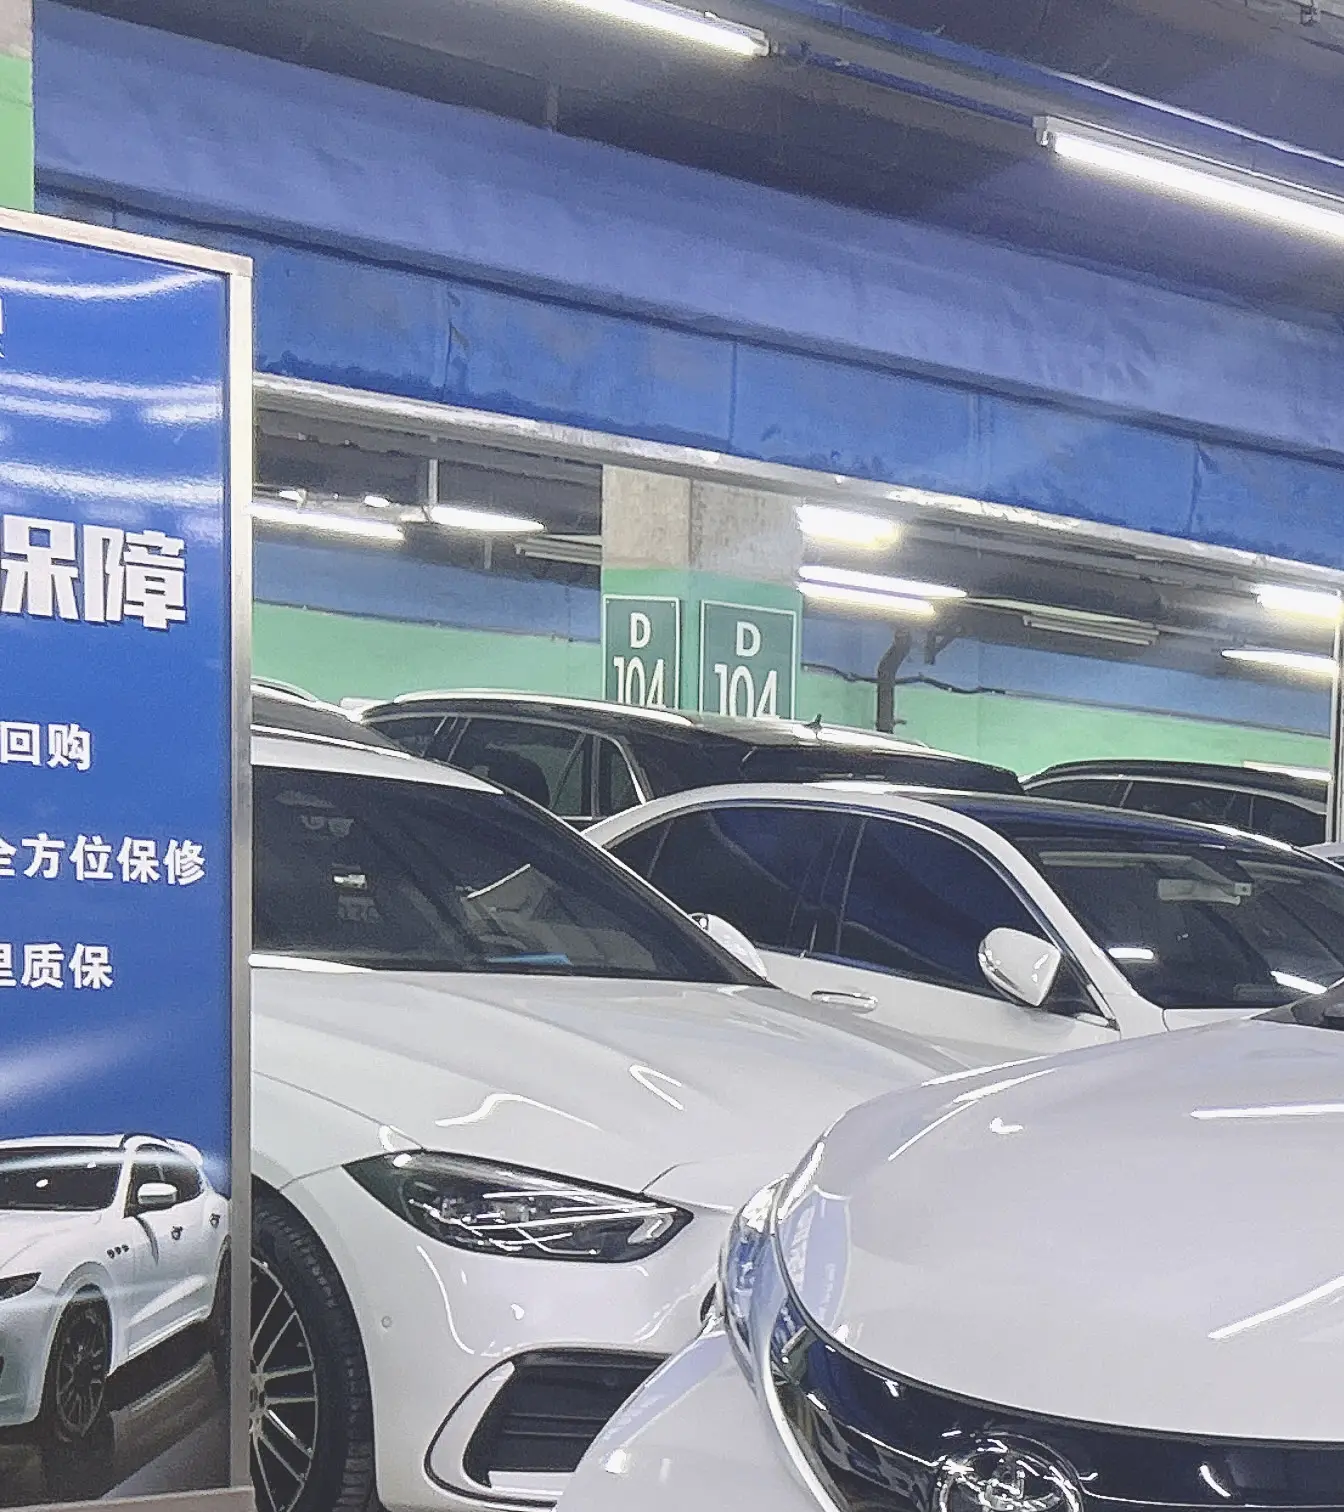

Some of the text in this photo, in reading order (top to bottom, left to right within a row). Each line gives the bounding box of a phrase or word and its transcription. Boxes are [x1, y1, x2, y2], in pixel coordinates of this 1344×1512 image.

[630, 612, 652, 649] D
[736, 621, 762, 657] D
[613, 656, 667, 710] 104
[714, 662, 780, 720] 104
[0, 721, 92, 772] 回购
